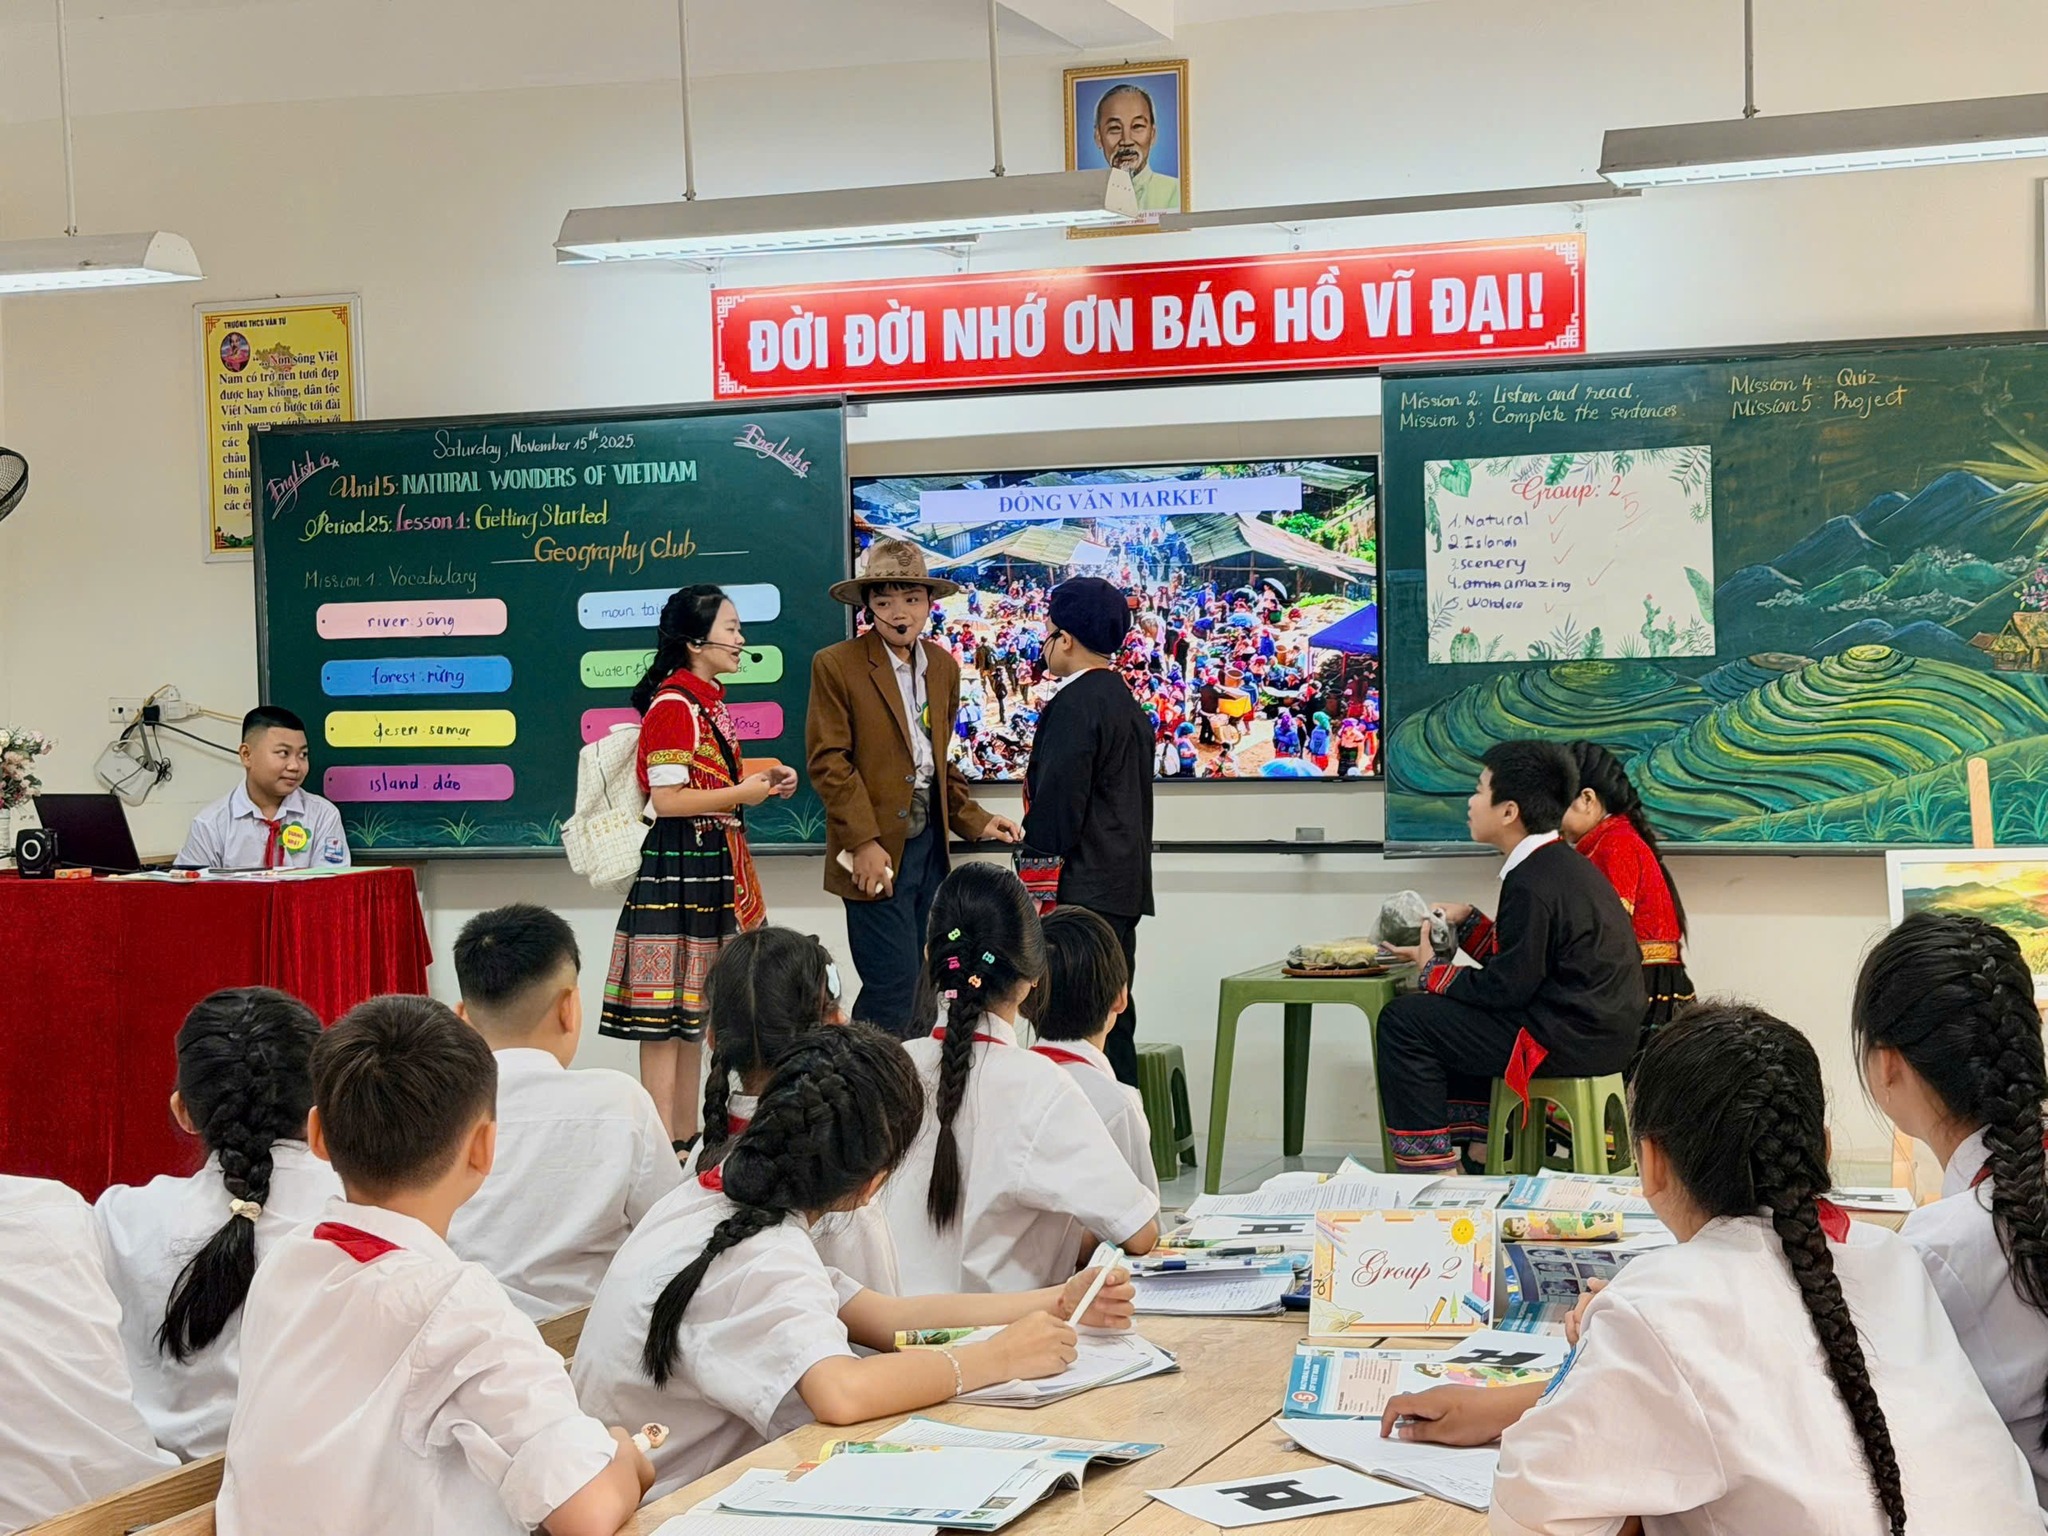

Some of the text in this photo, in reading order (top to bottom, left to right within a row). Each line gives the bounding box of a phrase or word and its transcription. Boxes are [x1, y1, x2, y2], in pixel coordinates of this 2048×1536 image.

[748, 266, 1544, 373] ĐỜI ĐỜI NHỚ ƠN BÁC HỒ VĨ ĐẠI!
[293, 353, 315, 365] sông
[318, 350, 338, 364] Việt
[220, 367, 339, 384] Nam có trở nên tươi đẹp
[1731, 375, 1797, 395] Mission
[1837, 368, 1881, 386] Quiz
[220, 382, 340, 402] được hay không, dân tộc
[1400, 390, 1462, 410] Mission
[1493, 384, 1542, 404] Listen
[1547, 383, 1579, 401] and
[1732, 395, 1799, 419] Mission
[1834, 385, 1908, 418] Project
[221, 398, 341, 418] Việt Nam có bước tới đài
[1400, 412, 1459, 431] Mission
[1492, 405, 1567, 433] Complete
[1574, 402, 1600, 423] the
[221, 421, 243, 432] vinh
[222, 437, 240, 448] các
[433, 429, 509, 464] Saturday,
[510, 431, 571, 454] November
[734, 423, 812, 473] English 6
[222, 452, 246, 463] châu
[223, 483, 239, 495] lớn
[266, 450, 331, 512] English 6
[383, 475, 399, 496] 5:
[402, 470, 483, 494] NATURAL
[489, 466, 577, 491] WONDERS
[584, 464, 607, 486] OF
[611, 460, 698, 485] VIETNAM
[224, 500, 240, 511] các
[999, 486, 1219, 514] ĐỒNG VĂN MARKET
[1511, 475, 1623, 509] Group: 2
[298, 509, 366, 542] Period
[368, 513, 393, 533] 25:
[395, 503, 453, 532] Lesson
[474, 503, 538, 539] Getting
[539, 498, 610, 528] Started
[1464, 511, 1529, 526] Natural
[534, 528, 697, 575] Geography Club
[304, 569, 361, 589] Mission
[388, 561, 478, 594] Vocabulary
[1460, 558, 1527, 574] scenery
[1351, 1249, 1462, 1290] Group 2
